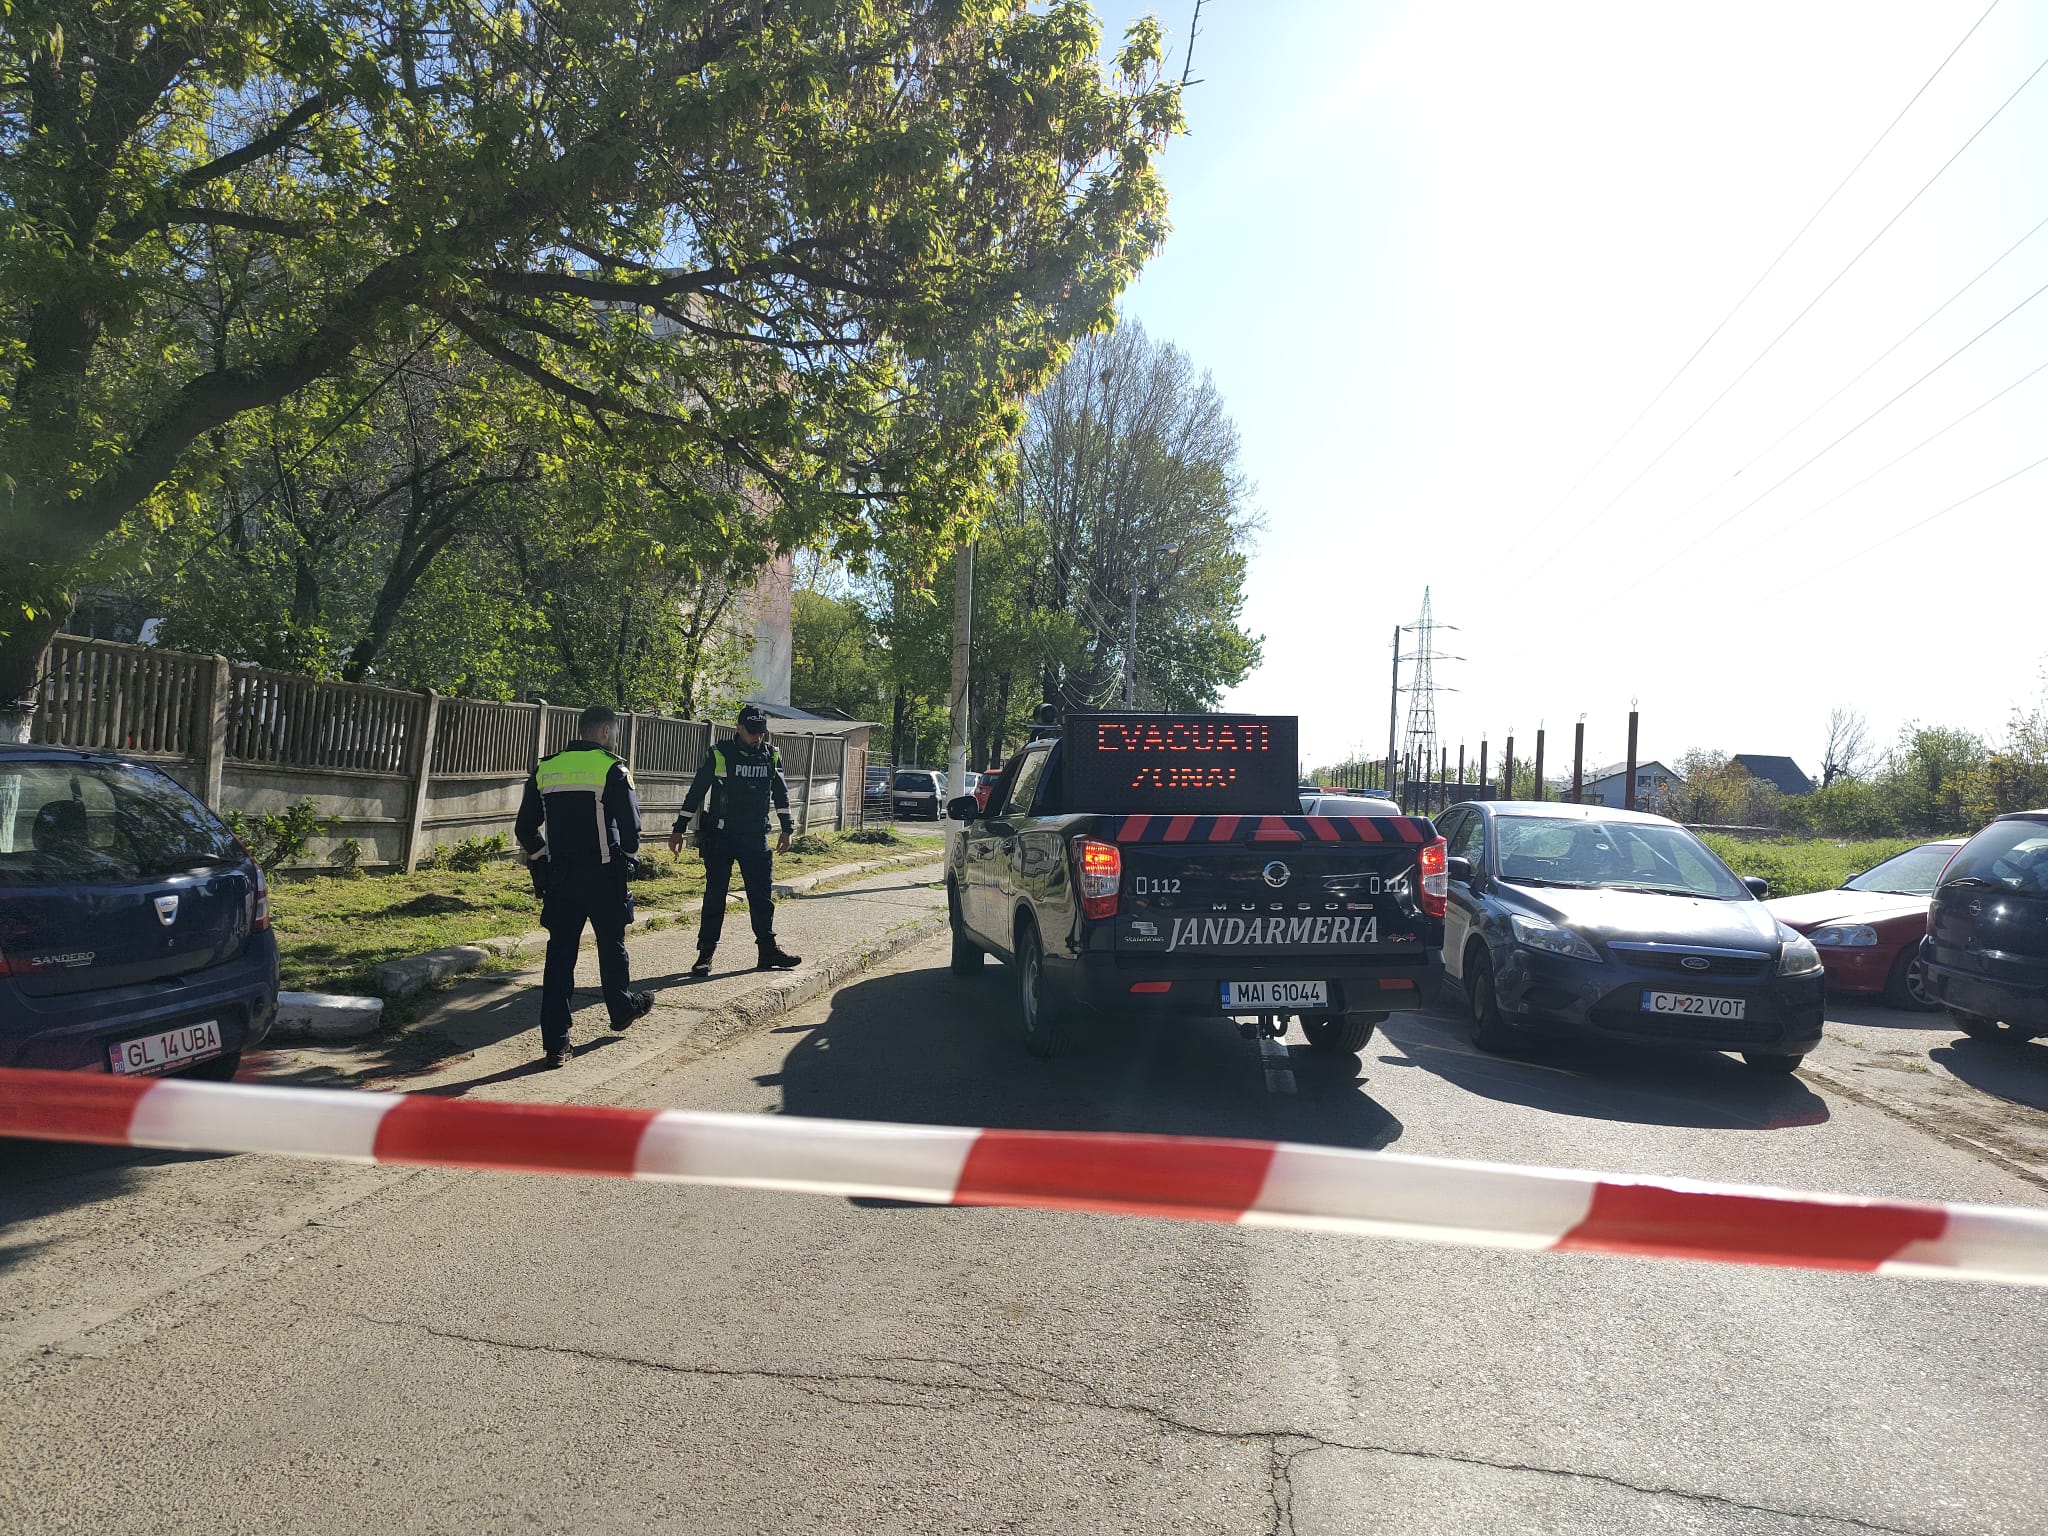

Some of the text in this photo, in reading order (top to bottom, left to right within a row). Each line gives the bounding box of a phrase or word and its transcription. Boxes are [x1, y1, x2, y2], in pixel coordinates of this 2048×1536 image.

[1151, 878, 1181, 893] 112
[1383, 878, 1409, 894] 112
[1212, 903, 1339, 911] MUSSO
[1166, 917, 1379, 952] JANDARMERIA
[31, 951, 95, 966] SANDERO
[1238, 983, 1320, 1002] MAI 61044
[1655, 995, 1743, 1016] CJ 22 VOT
[128, 1042, 155, 1067] GL
[161, 1034, 179, 1059] 14
[181, 1025, 216, 1052] UBA
[114, 1061, 124, 1073] RO
